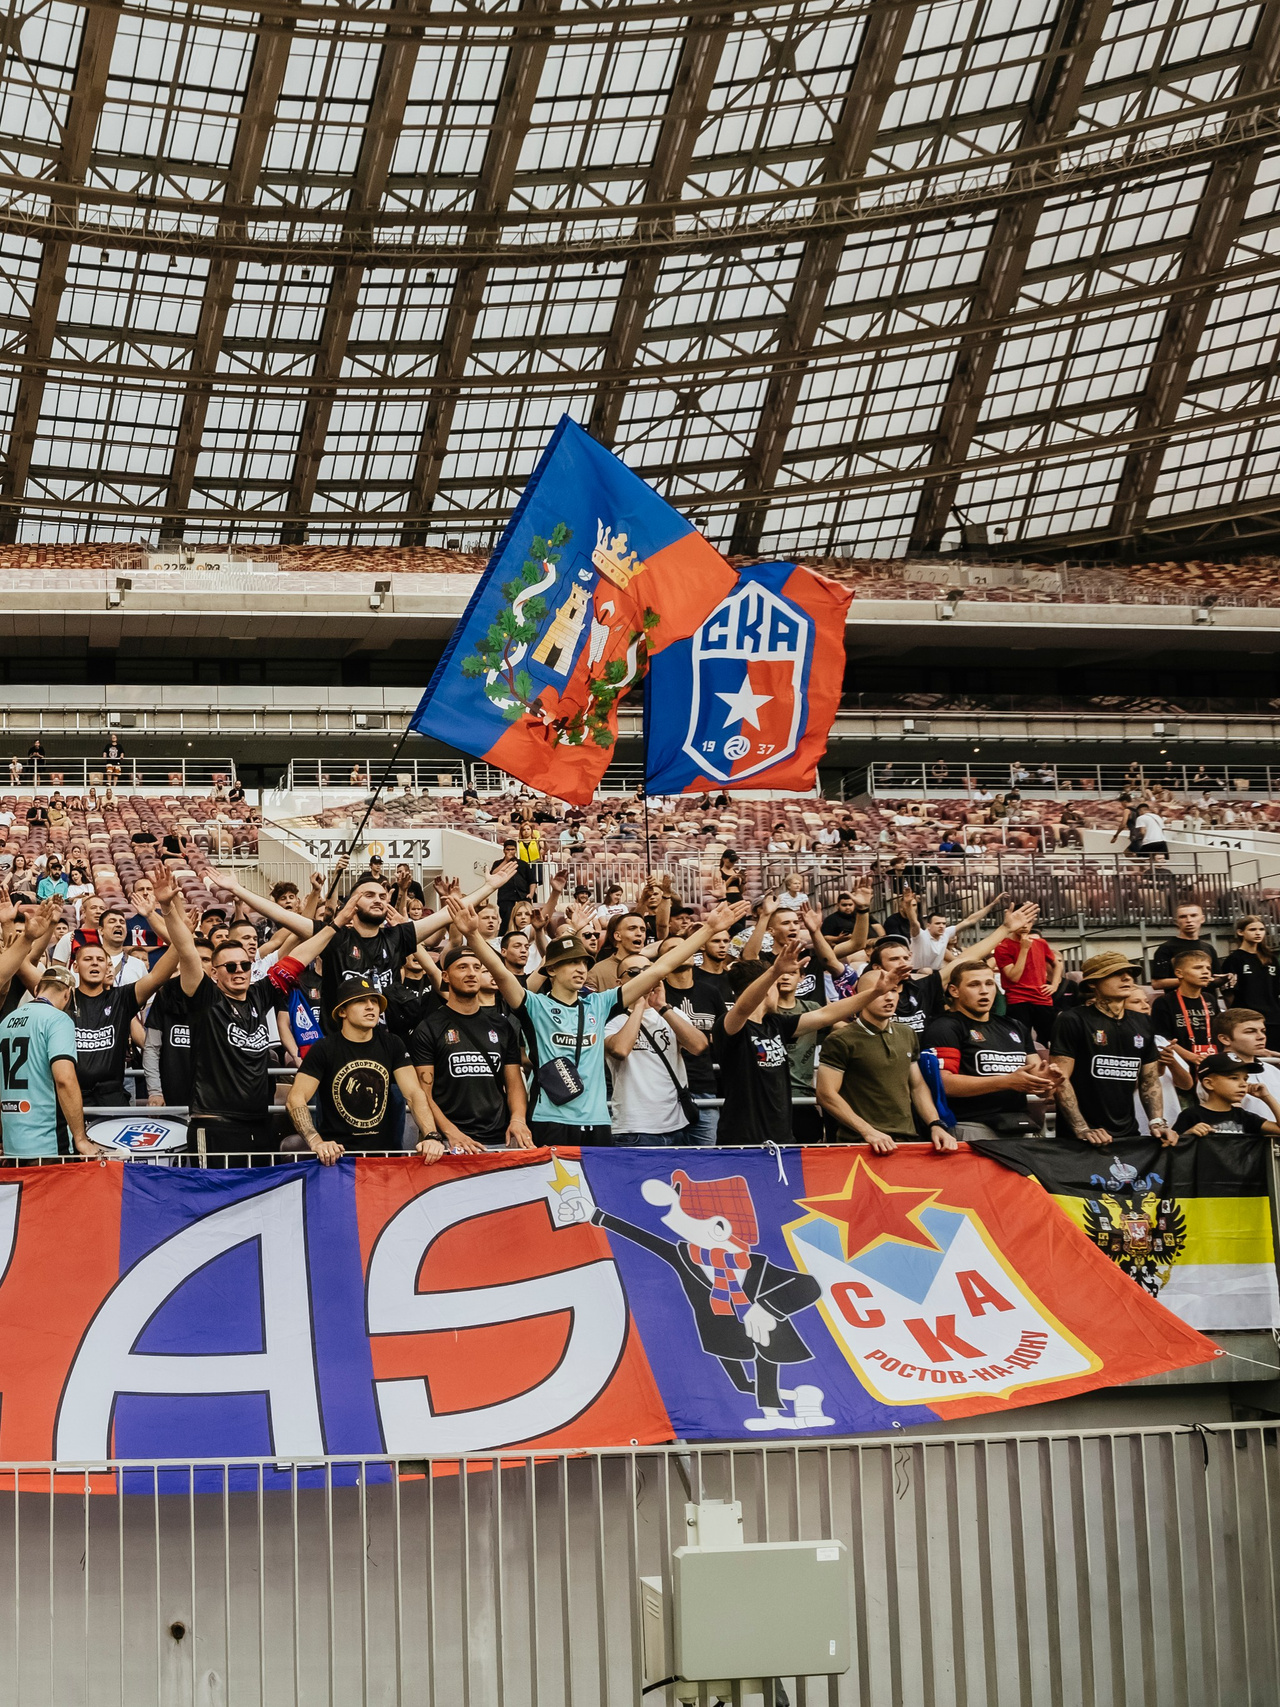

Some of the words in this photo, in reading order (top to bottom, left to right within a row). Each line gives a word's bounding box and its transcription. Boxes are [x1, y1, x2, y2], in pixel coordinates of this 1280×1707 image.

[699, 593, 800, 654] СКА
[702, 740, 716, 752] 19
[757, 743, 775, 755] 37
[388, 839, 431, 859] 123
[0, 1037, 30, 1090] 12
[830, 1269, 1017, 1364] СКА
[863, 1330, 1049, 1385] РОСТОВ-НА-ДОНУ
